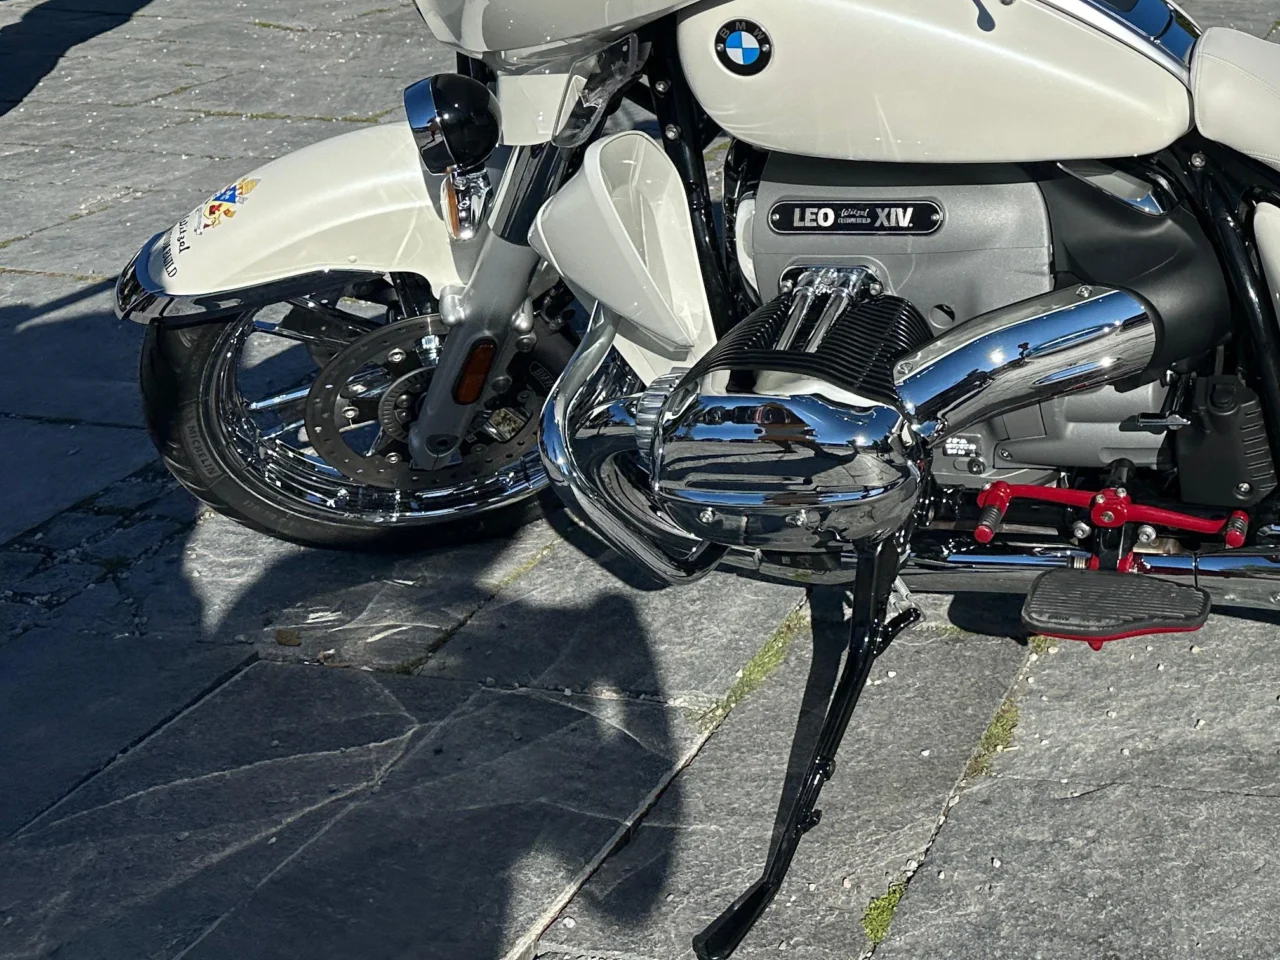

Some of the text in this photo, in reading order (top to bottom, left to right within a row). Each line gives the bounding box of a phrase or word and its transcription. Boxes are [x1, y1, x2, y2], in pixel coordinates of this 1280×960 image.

[719, 21, 766, 40] BMW
[793, 207, 835, 227] LEO
[186, 424, 218, 478] MICHELIN
